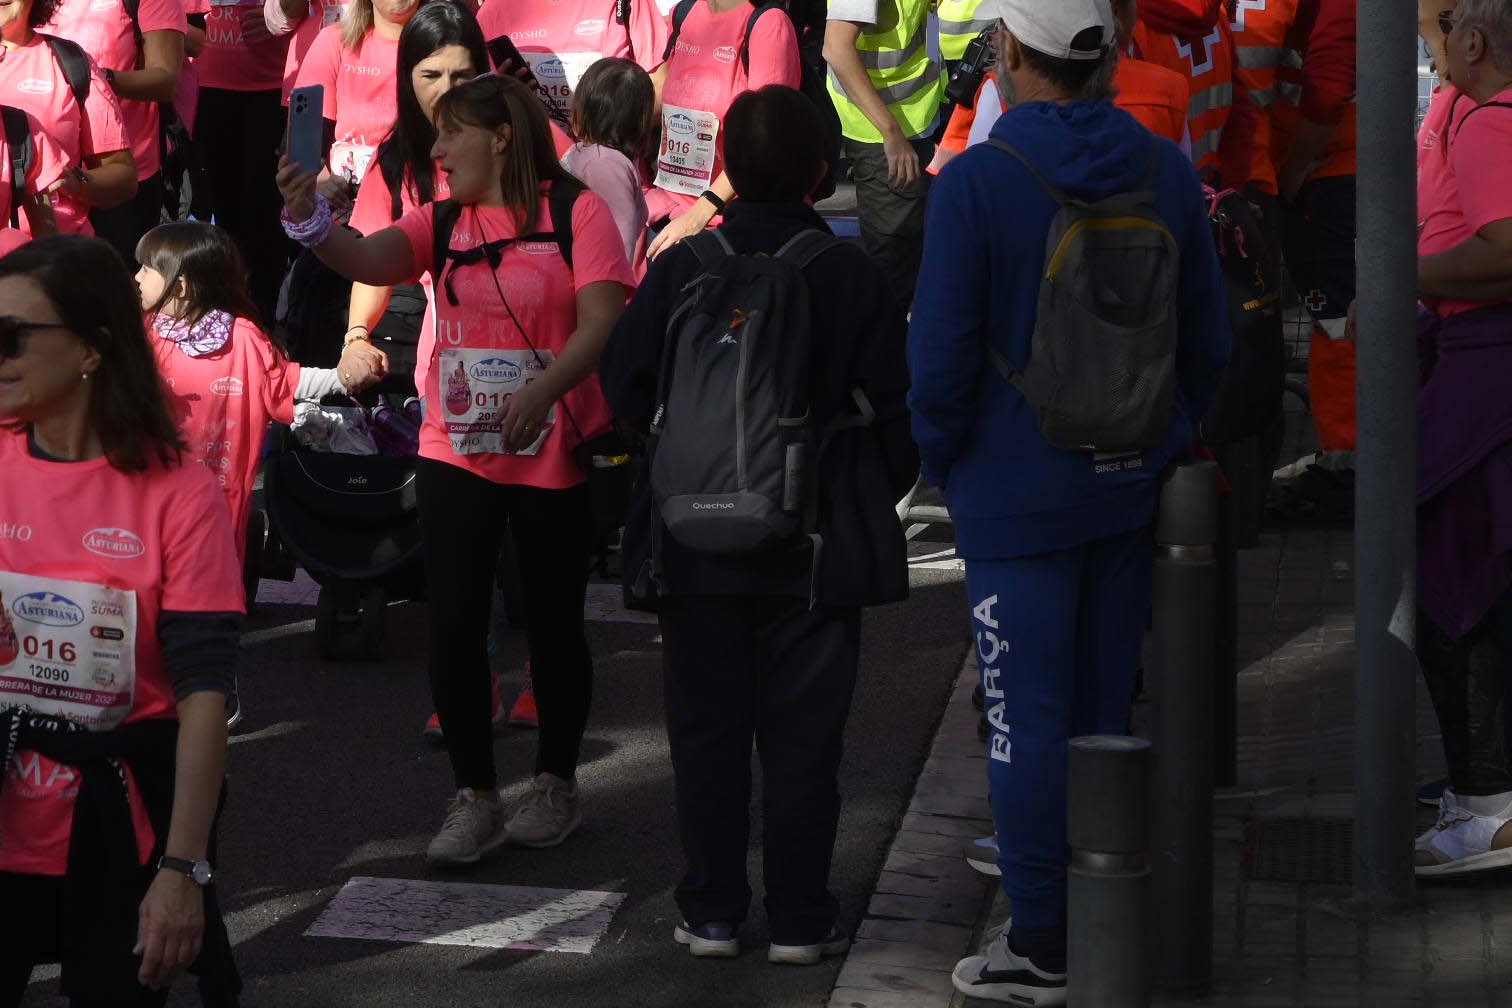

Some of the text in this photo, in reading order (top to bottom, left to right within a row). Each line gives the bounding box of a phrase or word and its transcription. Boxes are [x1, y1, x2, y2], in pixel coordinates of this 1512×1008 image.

[205, 26, 245, 45] UMA
[668, 139, 690, 154] 016
[473, 364, 518, 379] ASTURIANA
[1095, 463, 1122, 474] SINCE
[693, 501, 734, 510] Quechua
[86, 532, 144, 554] ASTURIANA
[19, 598, 79, 622] ASTURIANA
[90, 605, 125, 619] SUMA
[22, 635, 78, 663] 016
[28, 664, 70, 683] 12090
[973, 594, 1012, 764] BARÇA
[32, 684, 44, 694] DE
[45, 685, 58, 696] LA
[59, 688, 92, 703] MUJER
